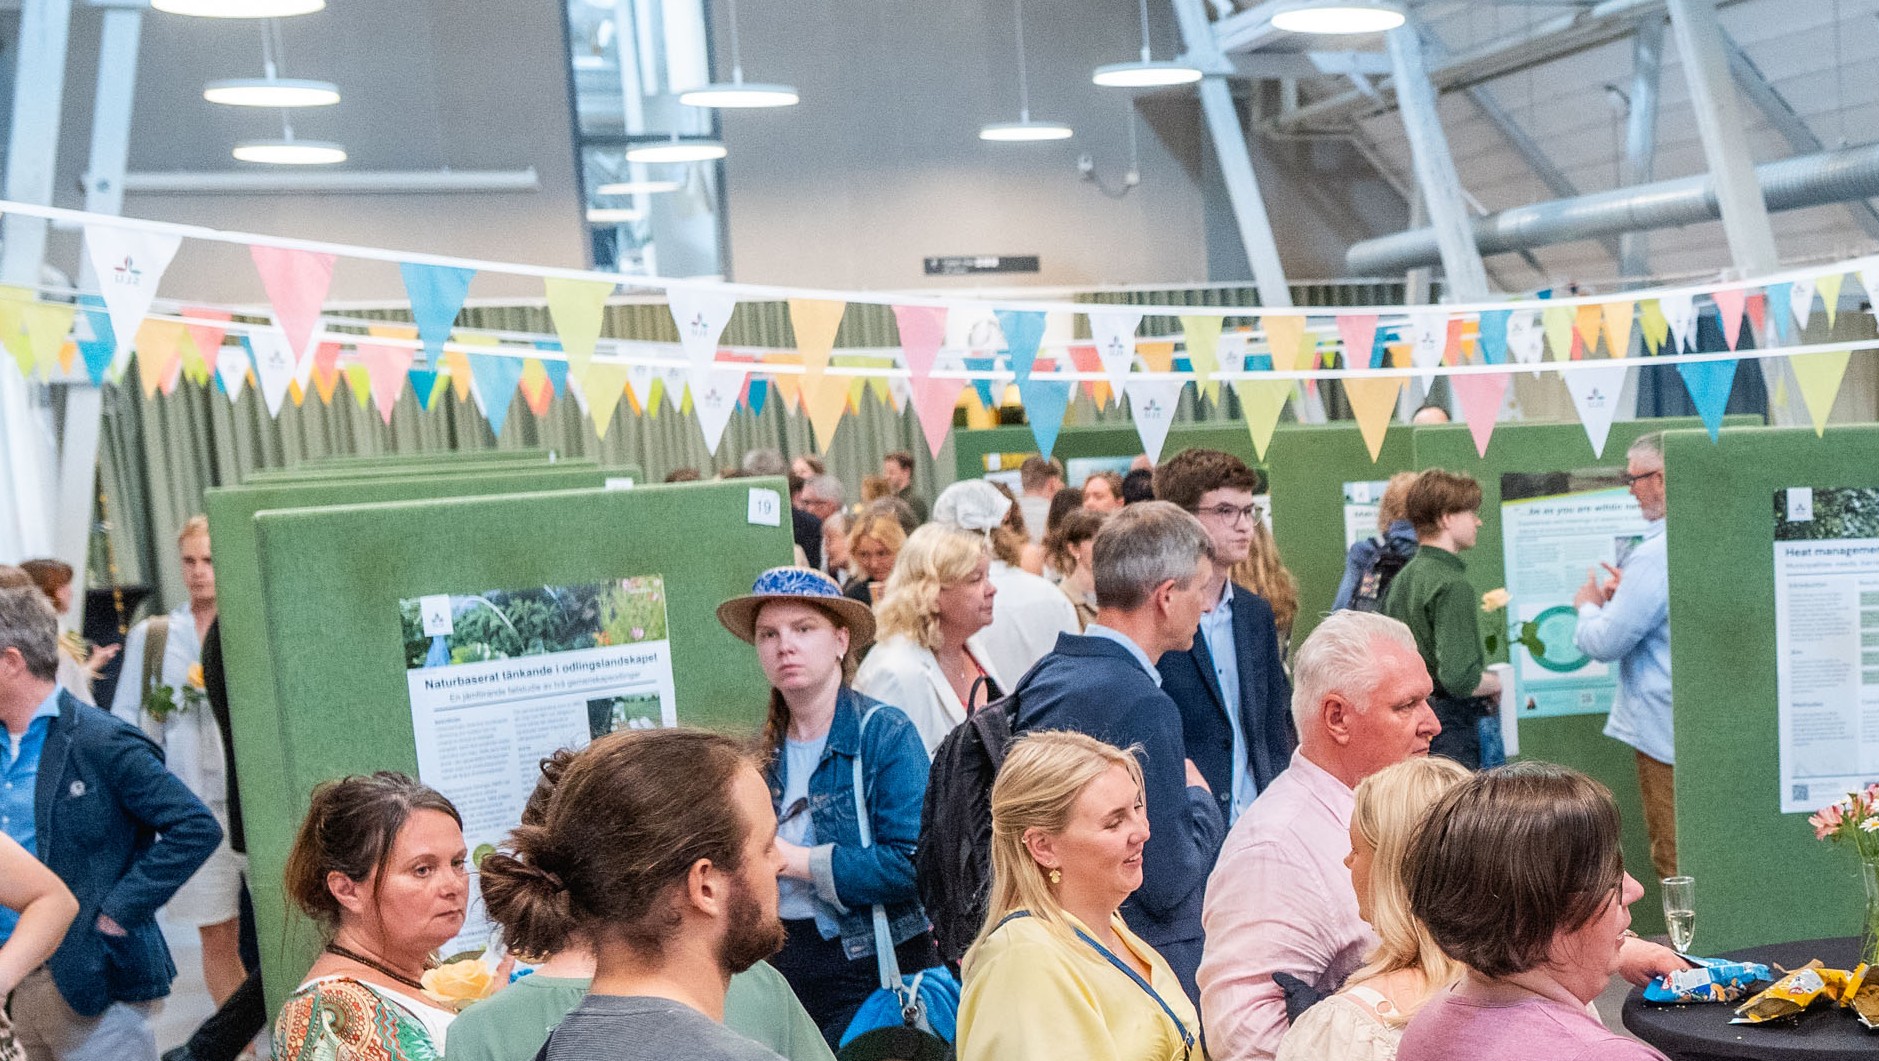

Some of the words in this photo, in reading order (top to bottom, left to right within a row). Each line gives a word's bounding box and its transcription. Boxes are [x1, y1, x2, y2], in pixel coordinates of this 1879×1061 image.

[758, 500, 771, 515] 19
[1785, 548, 1811, 557] Heat
[425, 672, 499, 690] Naturbaserat
[502, 665, 553, 680] tänkande
[562, 652, 658, 674] odlingslandskapet
